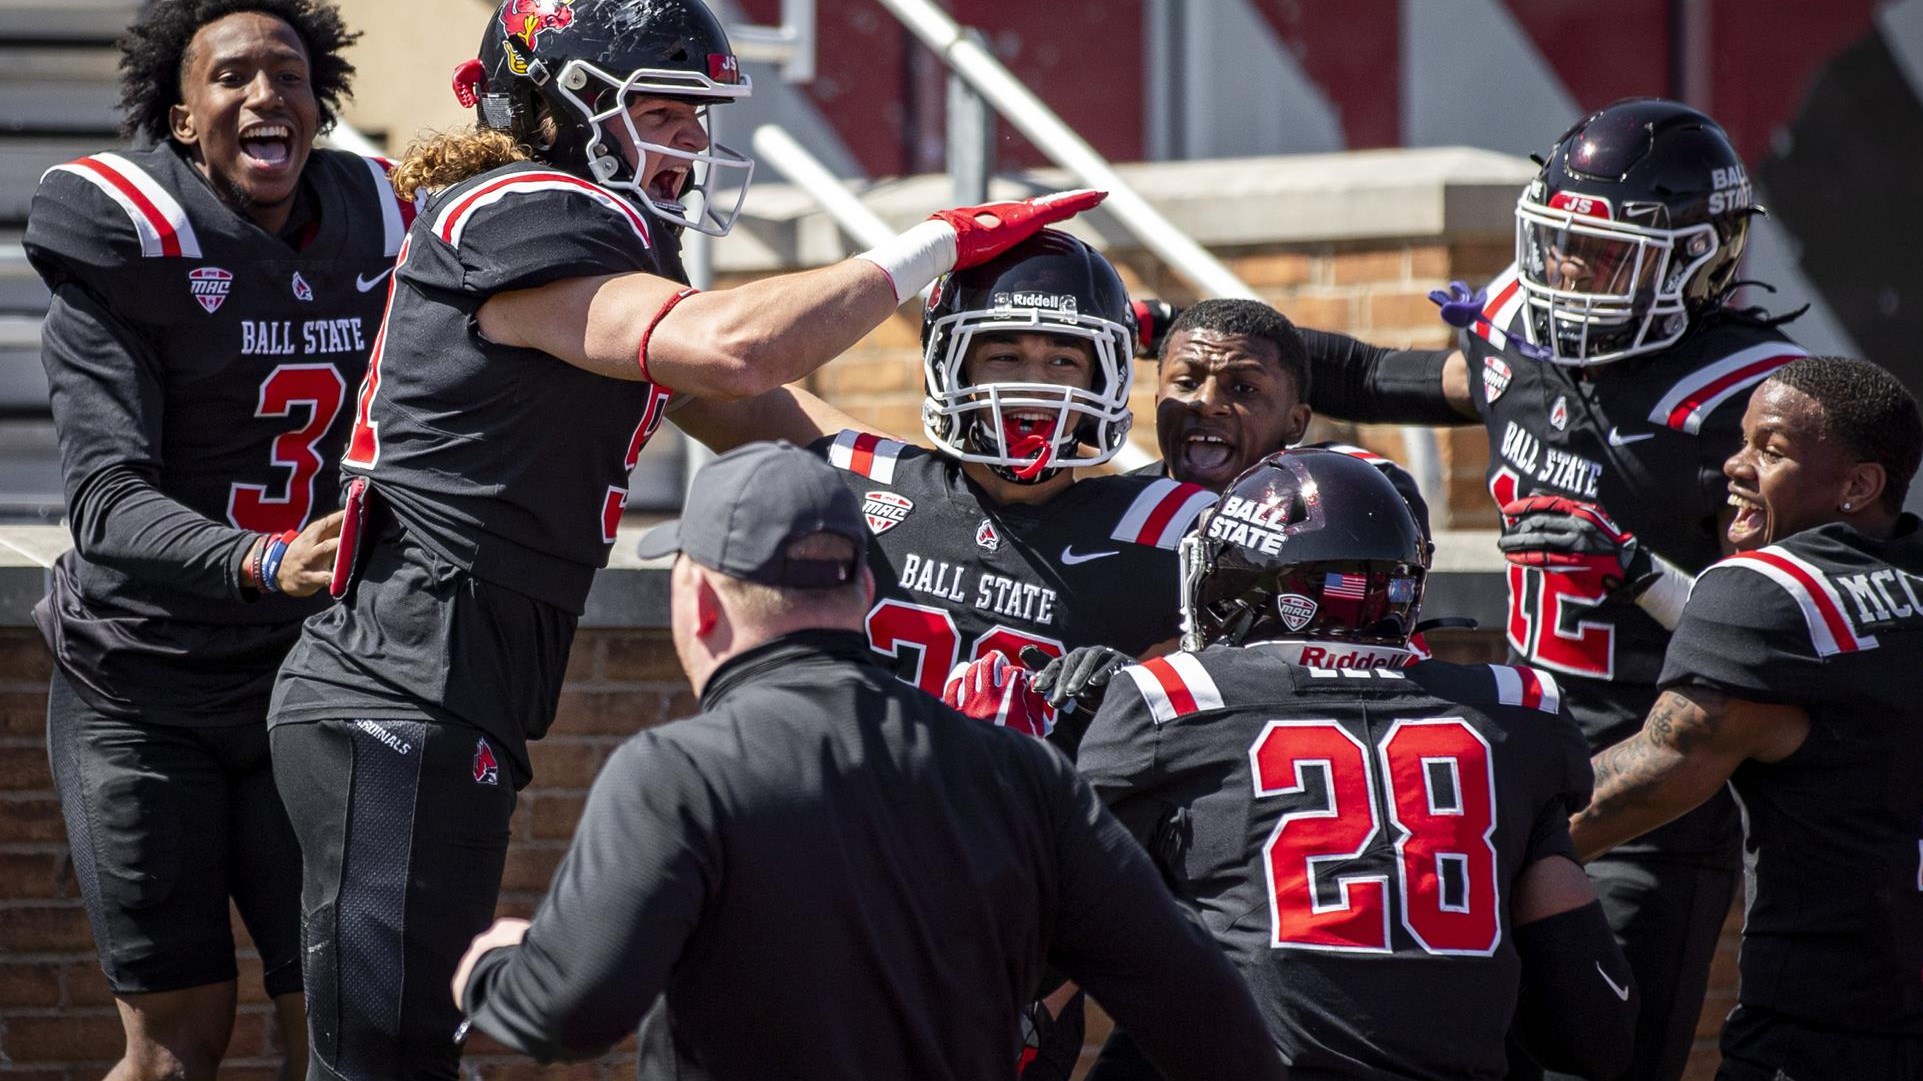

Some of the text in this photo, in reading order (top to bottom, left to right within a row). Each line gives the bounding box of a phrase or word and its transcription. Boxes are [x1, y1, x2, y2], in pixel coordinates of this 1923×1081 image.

[722, 56, 737, 70] JS
[1563, 197, 1593, 214] JS
[190, 280, 232, 294] MAC
[1013, 293, 1059, 308] Riddell
[241, 318, 365, 355] BALL STATE
[226, 362, 347, 534] 3
[1500, 420, 1603, 499] BALL STATE
[861, 499, 908, 522] MAC
[1220, 496, 1286, 532] BALL
[1208, 516, 1288, 556] STATE
[899, 553, 1057, 625] BALL STATE
[1281, 604, 1312, 618] MAC
[1298, 645, 1404, 670] Riddell
[1248, 716, 1502, 957] 28
